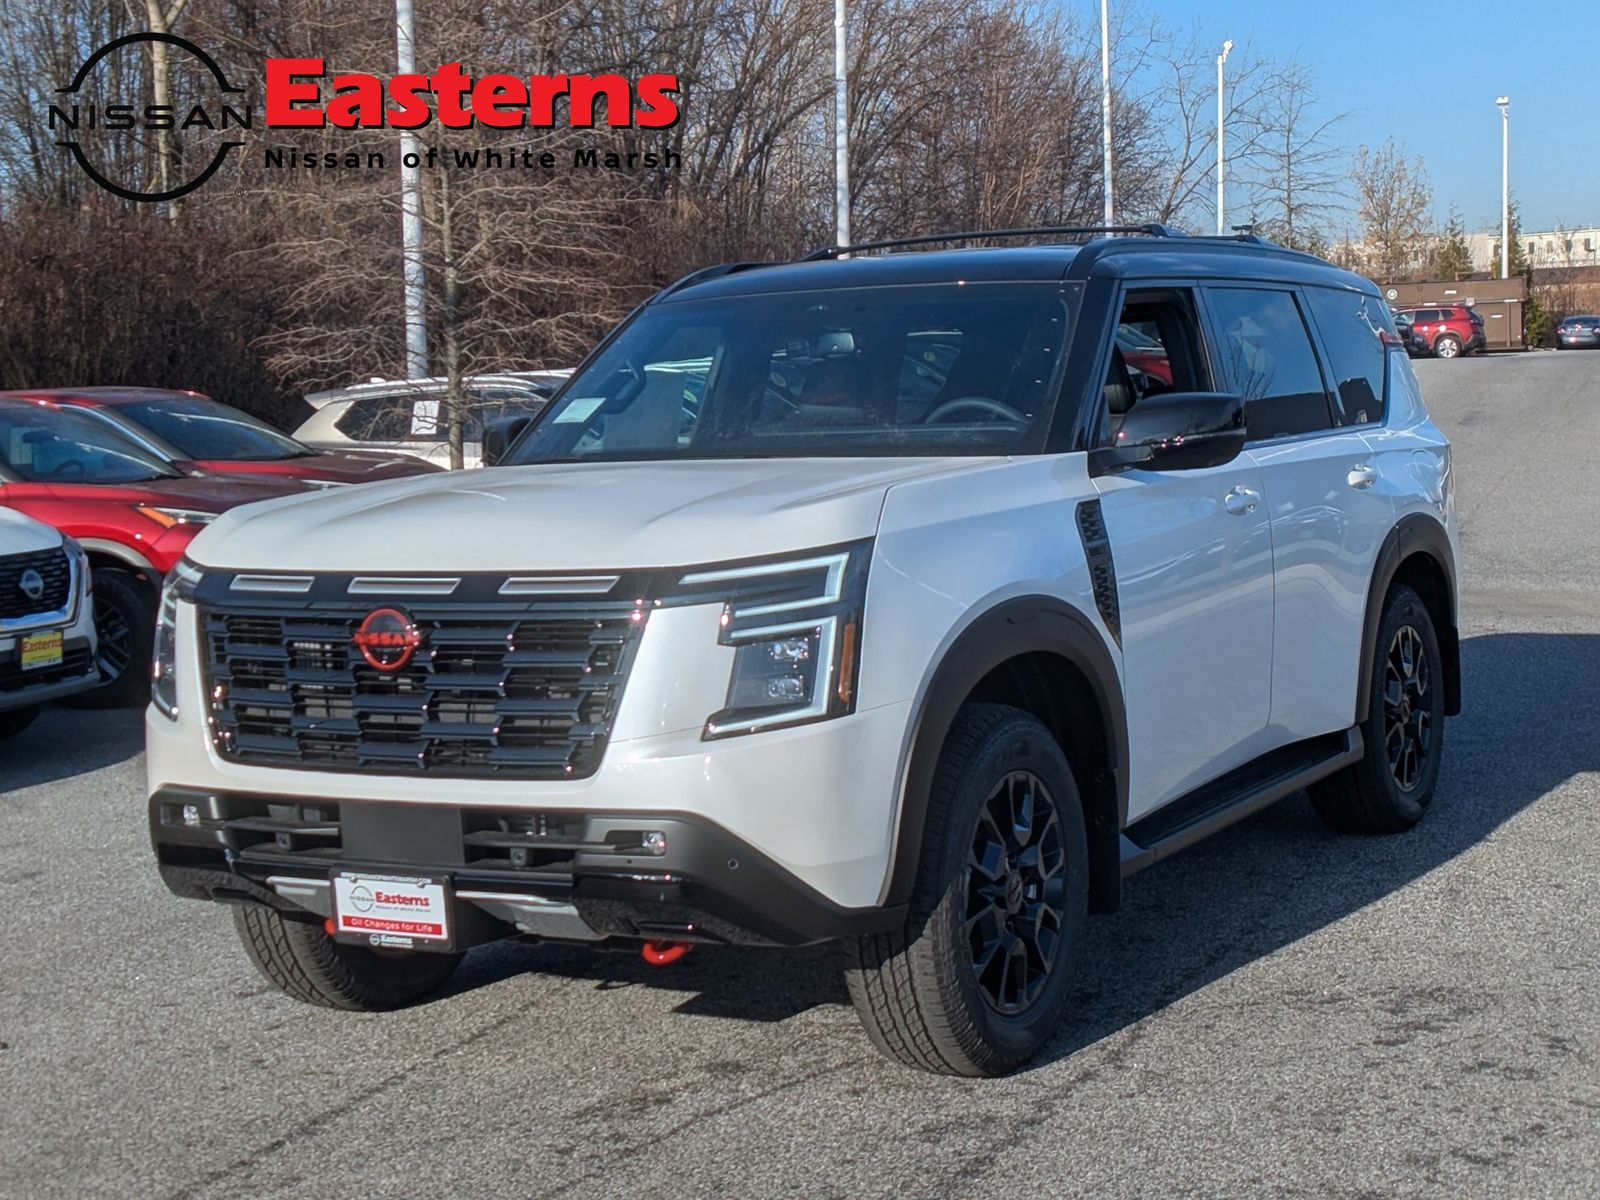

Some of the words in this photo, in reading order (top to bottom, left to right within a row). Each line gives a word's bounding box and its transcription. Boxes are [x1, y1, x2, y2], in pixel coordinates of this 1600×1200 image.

[375, 891, 430, 907] Easterns
[351, 918, 363, 926] Oil
[364, 919, 400, 931] Changes
[401, 922, 414, 930] for
[416, 924, 433, 933] Life
